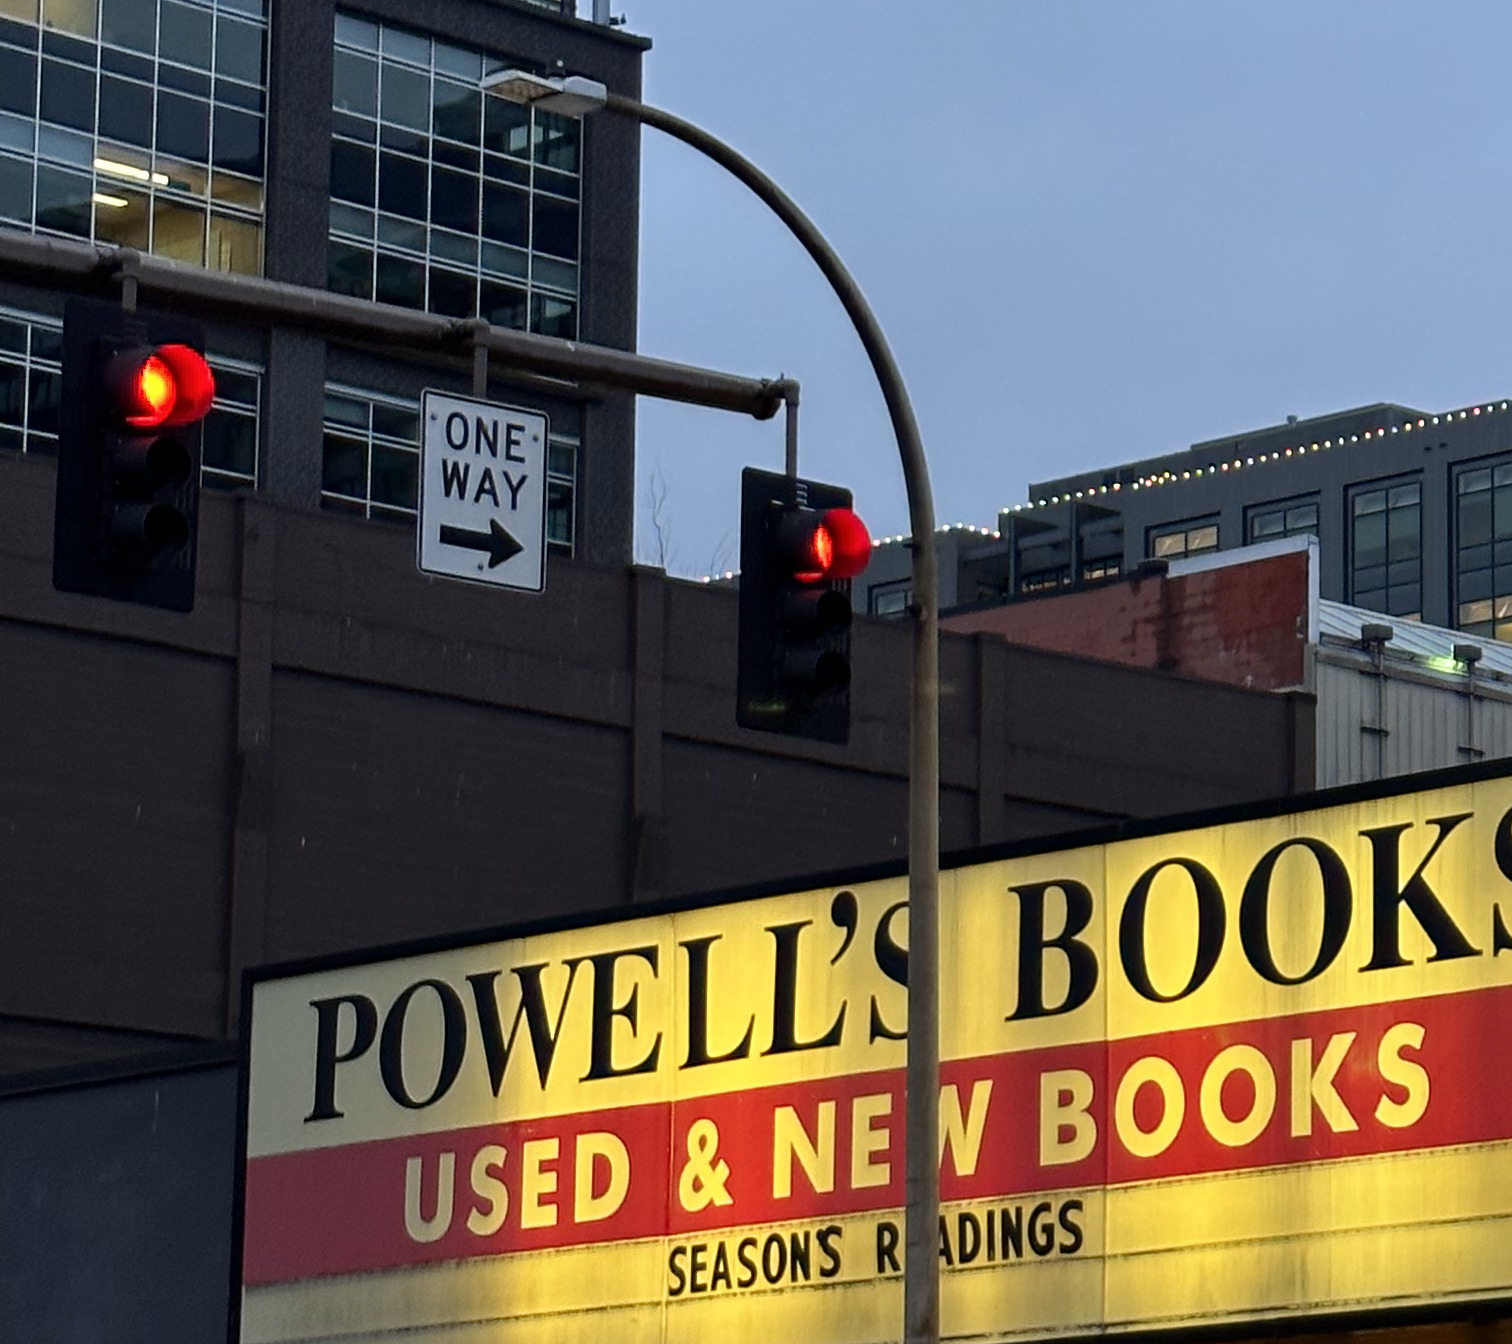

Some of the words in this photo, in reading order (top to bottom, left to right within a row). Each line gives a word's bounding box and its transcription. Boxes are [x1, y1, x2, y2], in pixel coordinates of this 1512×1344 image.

[445, 412, 525, 464] ONE
[442, 457, 528, 511] WAY
[304, 890, 909, 1122] POWELL'S
[404, 1133, 632, 1244] USED
[678, 1118, 733, 1213] &
[773, 1078, 993, 1199] NEW
[1039, 1022, 1431, 1166] BOOKS
[877, 1199, 1083, 1273] RADINGS
